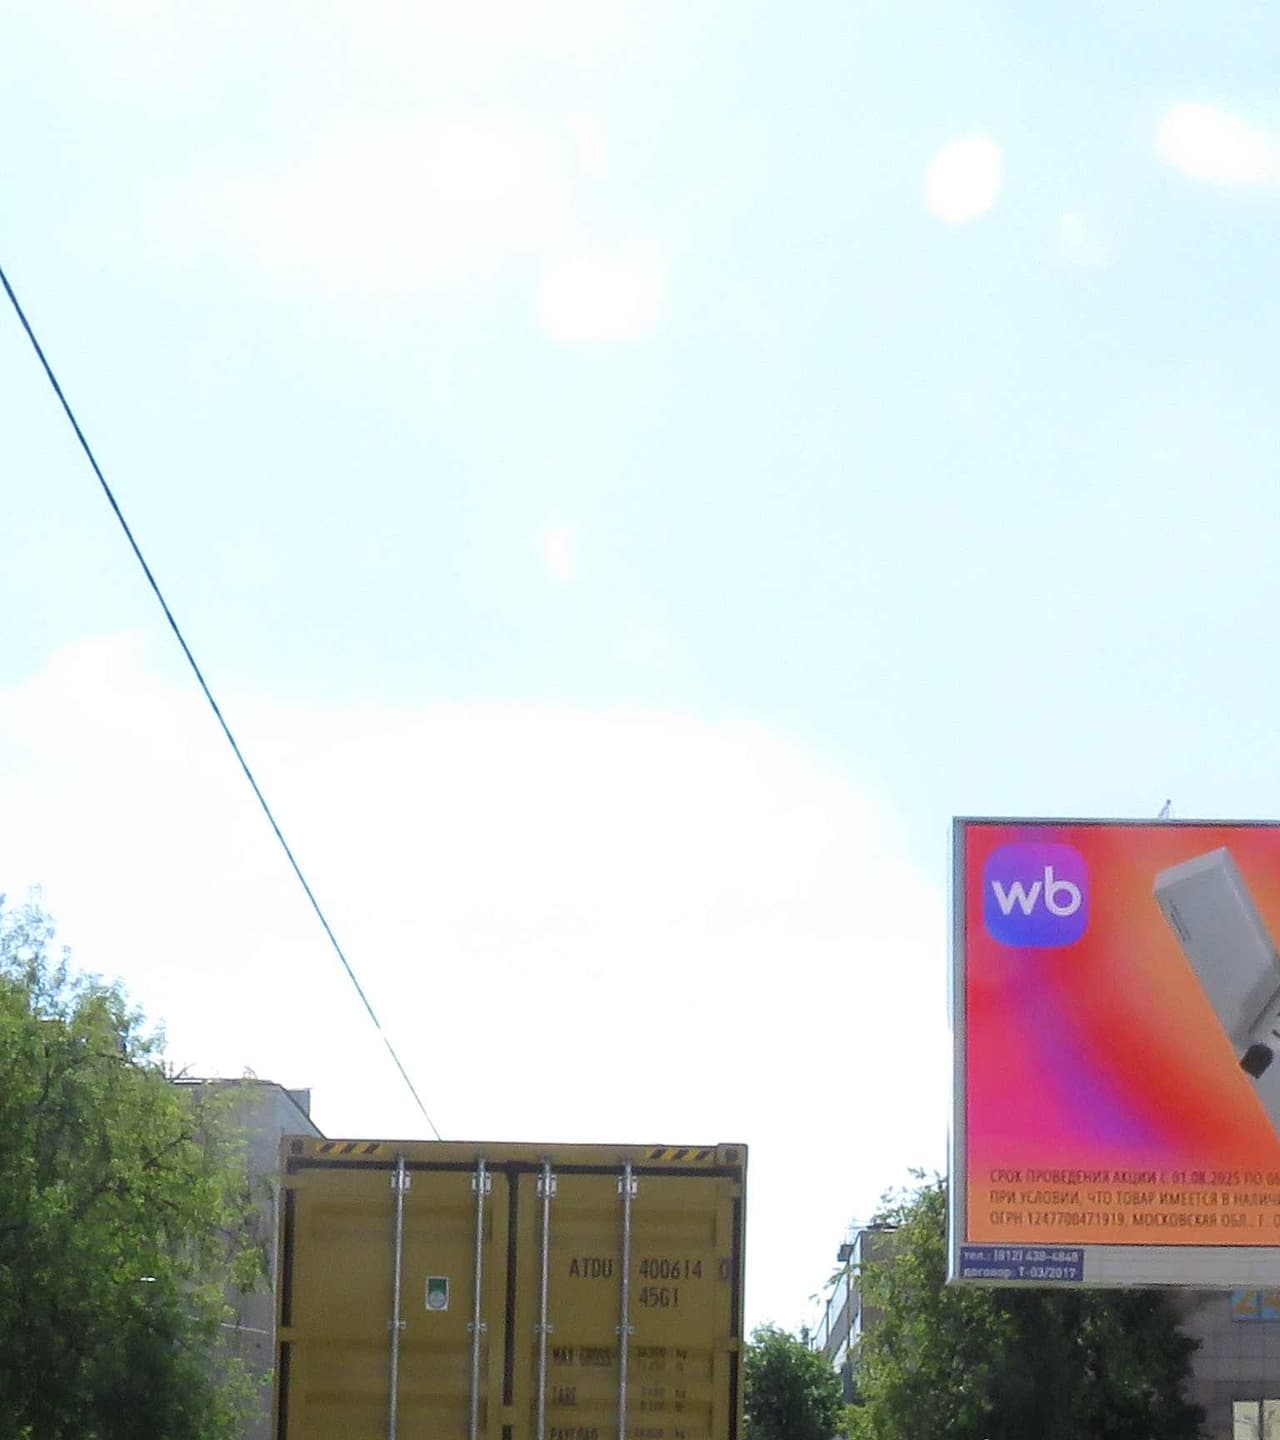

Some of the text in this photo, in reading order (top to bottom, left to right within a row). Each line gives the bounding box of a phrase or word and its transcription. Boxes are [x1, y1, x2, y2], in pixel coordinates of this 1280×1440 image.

[991, 865, 1082, 917] wb
[989, 1168, 1023, 1184] СРОК
[1026, 1169, 1110, 1186] ПРОВЕДЕНИЯ
[989, 1191, 1017, 1205] ПРИ
[1087, 1191, 1112, 1205] ЧТО
[639, 1259, 703, 1280] 400614
